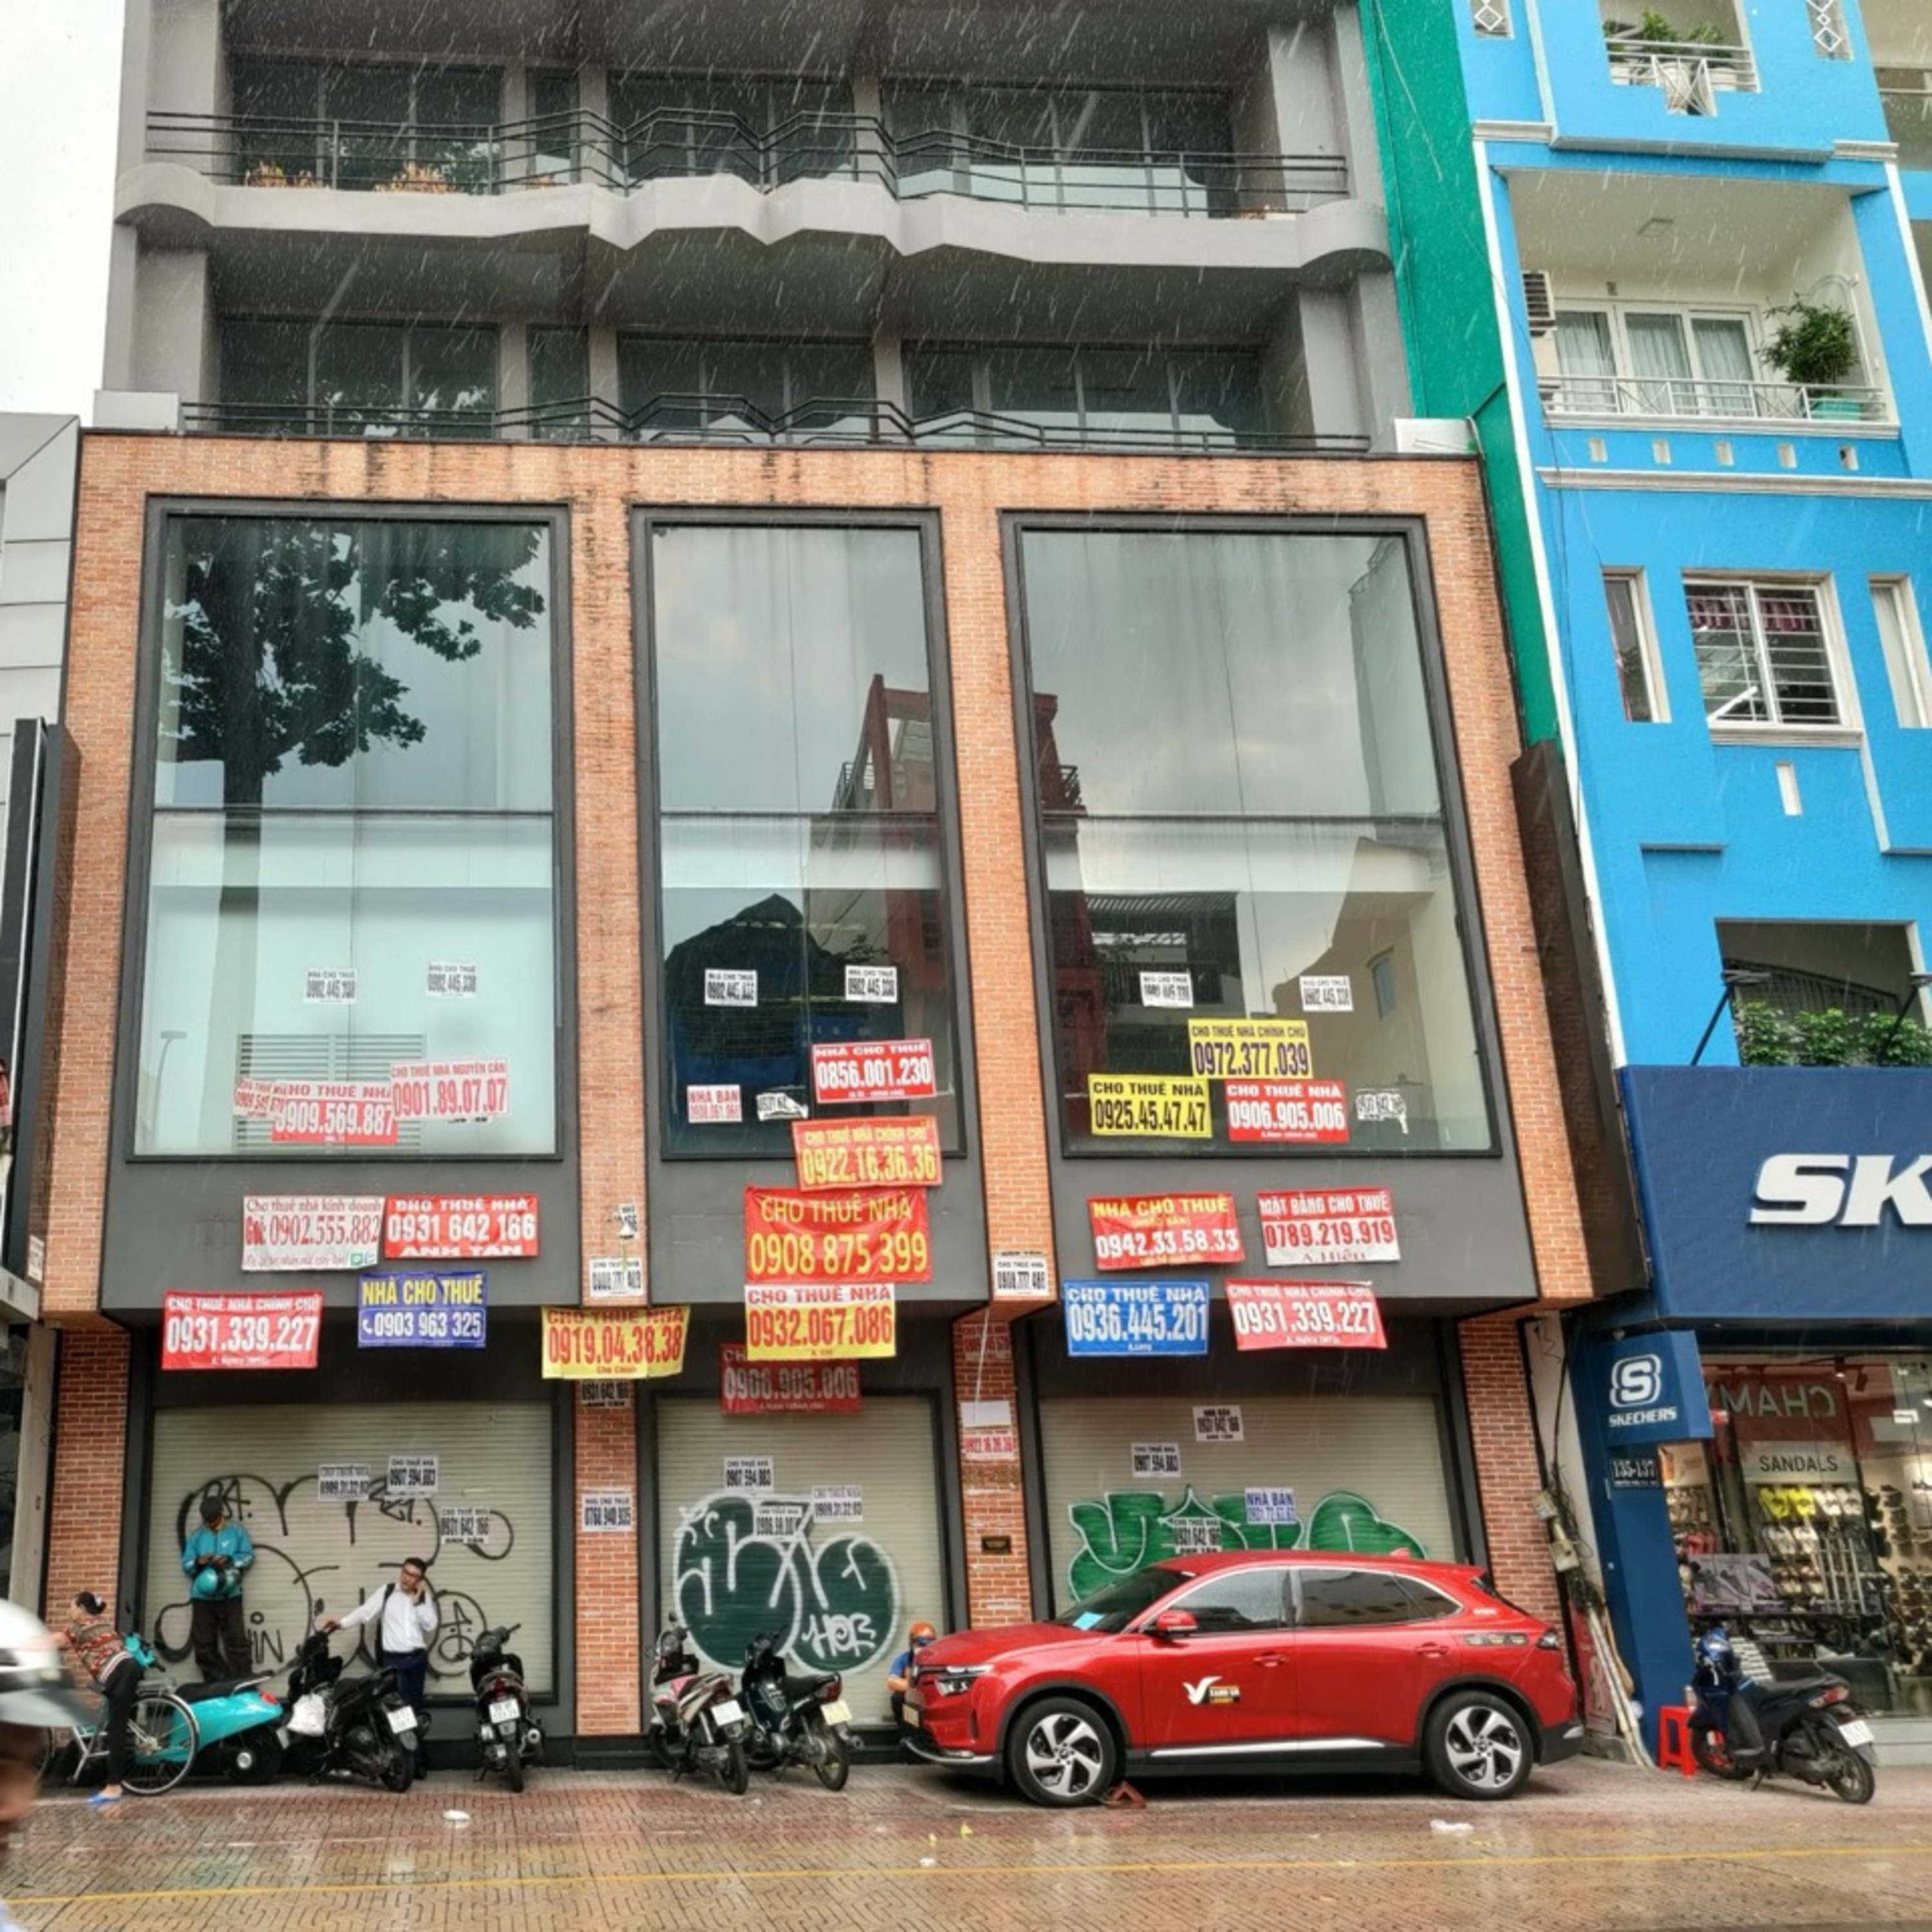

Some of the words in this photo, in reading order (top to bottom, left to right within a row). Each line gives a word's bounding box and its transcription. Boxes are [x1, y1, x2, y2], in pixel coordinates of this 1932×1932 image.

[1192, 1025, 1210, 1037] CHO
[853, 1045, 885, 1056] CHO
[1193, 1041, 1309, 1076] 0972.377.039
[817, 1056, 932, 1090] 0856.001.230
[1093, 1082, 1124, 1094] CHO
[1128, 1081, 1168, 1095] THUÊ
[392, 1077, 507, 1117] 0901.89.07.07
[1226, 1084, 1260, 1097] CHO
[1264, 1083, 1304, 1097] THUÊ
[1095, 1098, 1206, 1132] 0925.45.47.47
[1228, 1100, 1346, 1130] 0906.905.006
[802, 1144, 937, 1185] 0922.16.36.36
[1749, 1153, 1932, 1225] SK
[247, 1198, 269, 1212] Cho
[761, 1196, 804, 1223] CHO
[808, 1192, 863, 1223] THUÊ
[869, 1190, 912, 1220] NHÀ
[1092, 1197, 1132, 1218] NHÀ
[1327, 1195, 1356, 1215] CHO
[269, 1215, 380, 1245] 0902.555.882
[387, 1213, 440, 1243] 0931
[448, 1213, 491, 1242] 642
[497, 1213, 537, 1241] 166
[1264, 1219, 1394, 1249] 0789.219.919
[401, 1245, 460, 1256] ANH
[750, 1232, 816, 1275] 0908
[823, 1232, 872, 1275] 875
[879, 1231, 928, 1274] 399
[1095, 1228, 1240, 1259] 0942.33.58.33
[361, 1274, 398, 1306] NHÀ
[402, 1279, 437, 1305] CHO
[441, 1273, 483, 1304] THUÊ
[748, 1289, 787, 1304] CHO
[1068, 1287, 1106, 1303] CHO
[1112, 1285, 1160, 1303] THUÊ
[1166, 1283, 1206, 1302] NHÀ
[374, 1311, 414, 1338] 0903
[419, 1311, 448, 1338] 963
[451, 1311, 482, 1338] 325
[748, 1305, 894, 1348] 0932.067.086
[1069, 1303, 1208, 1341] 0936.445.201
[1232, 1300, 1376, 1335] 0931.339.227
[166, 1315, 319, 1353] 0931.339.227
[549, 1325, 683, 1365] 0919.04.38.38
[722, 1349, 746, 1363] CH
[724, 1366, 859, 1401] 0906.905.006
[1609, 1406, 1677, 1428] SKECHERS
[1758, 1455, 1839, 1473] SANDALS
